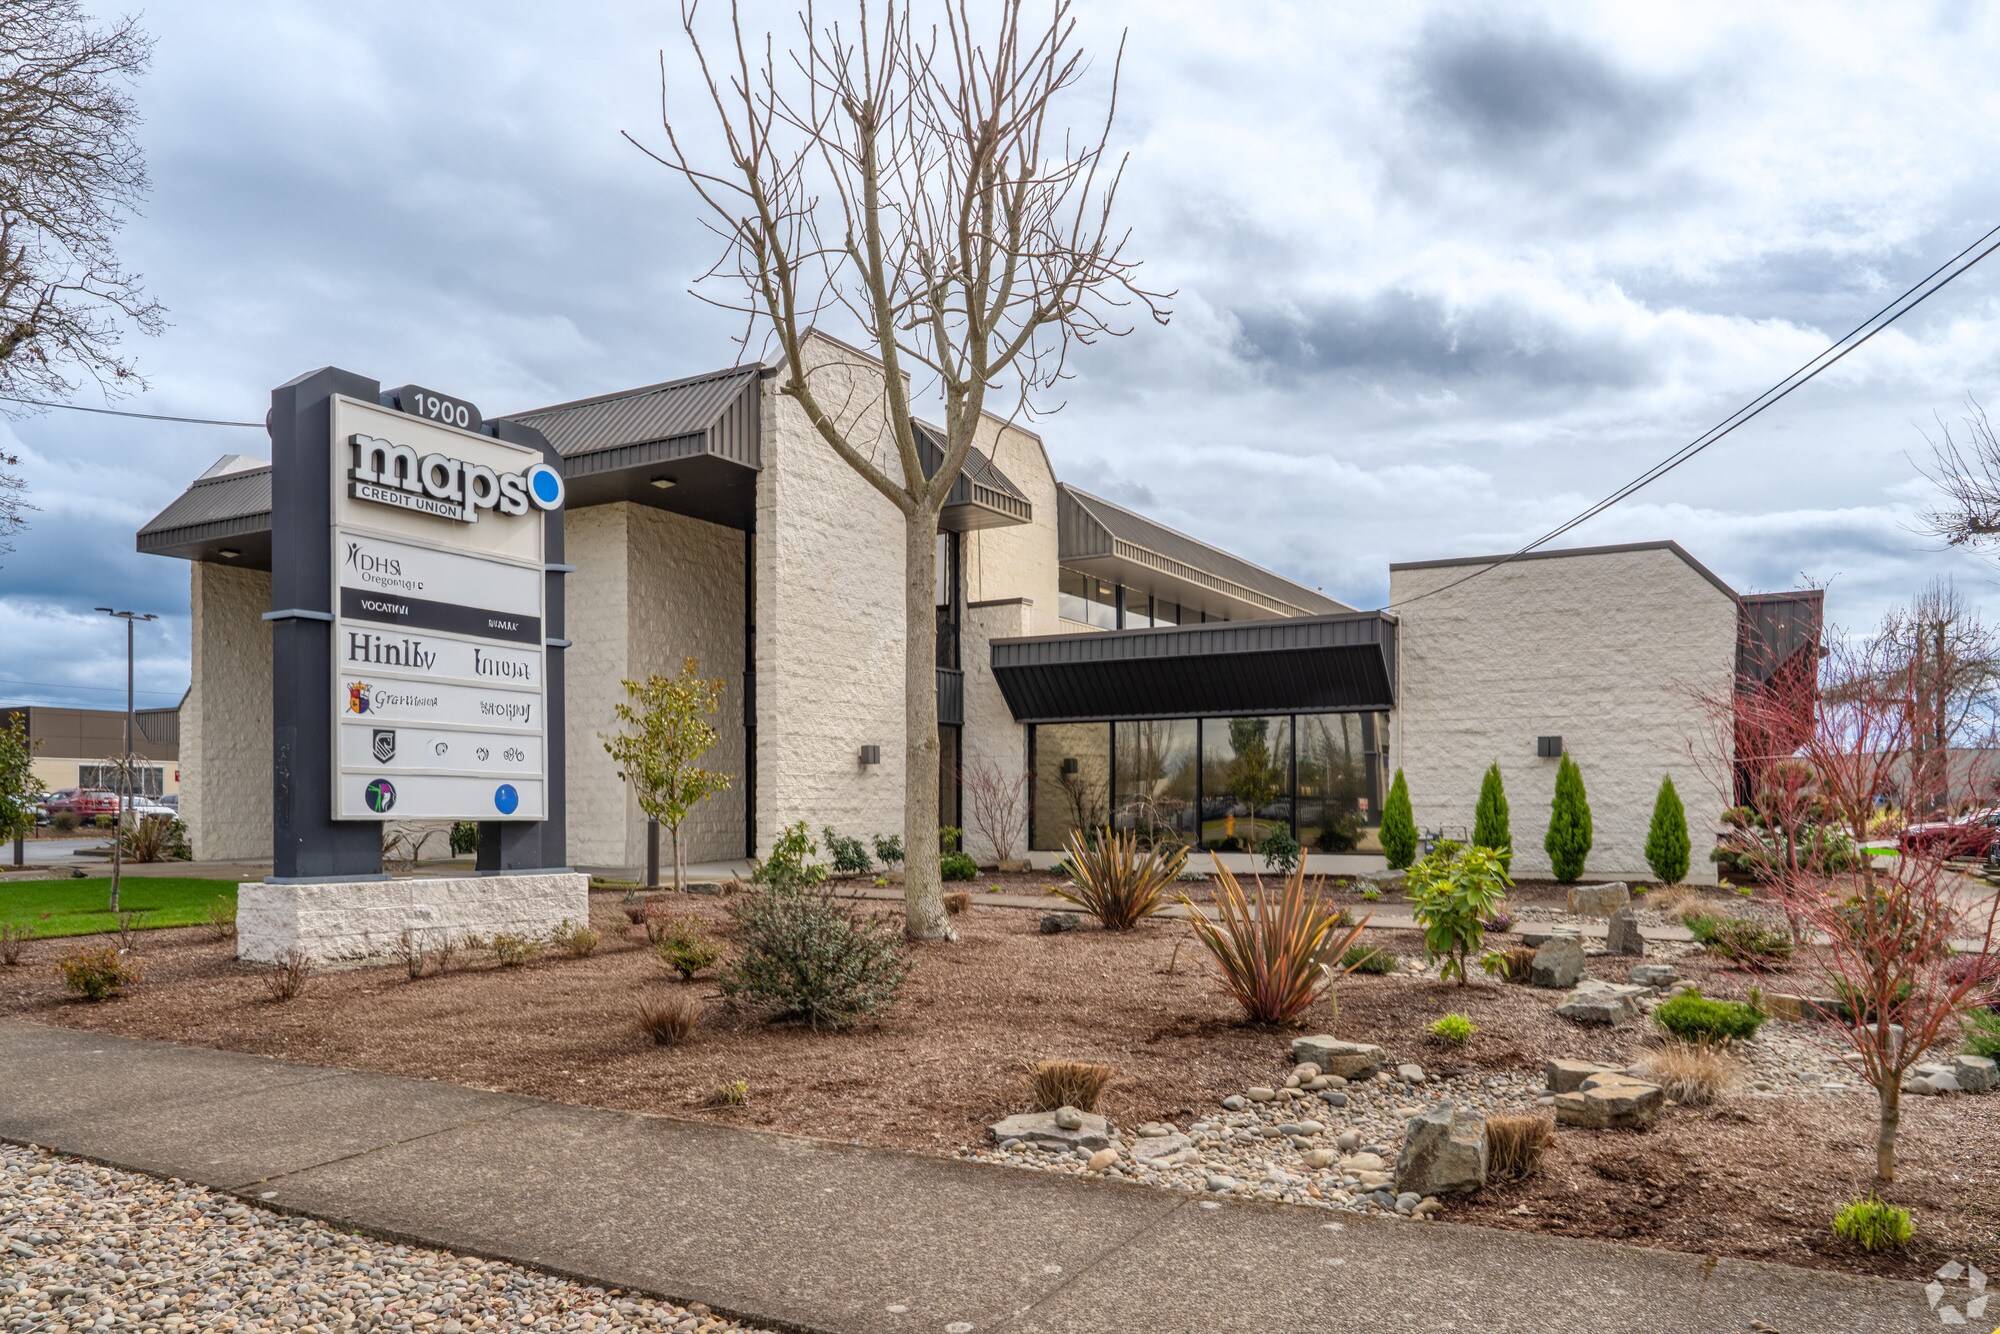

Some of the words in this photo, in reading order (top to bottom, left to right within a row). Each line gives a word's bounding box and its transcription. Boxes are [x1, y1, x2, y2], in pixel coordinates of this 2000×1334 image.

[414, 393, 469, 428] 1900
[349, 433, 529, 523] maps
[361, 486, 411, 506] CREDIT
[415, 498, 457, 517] UNION
